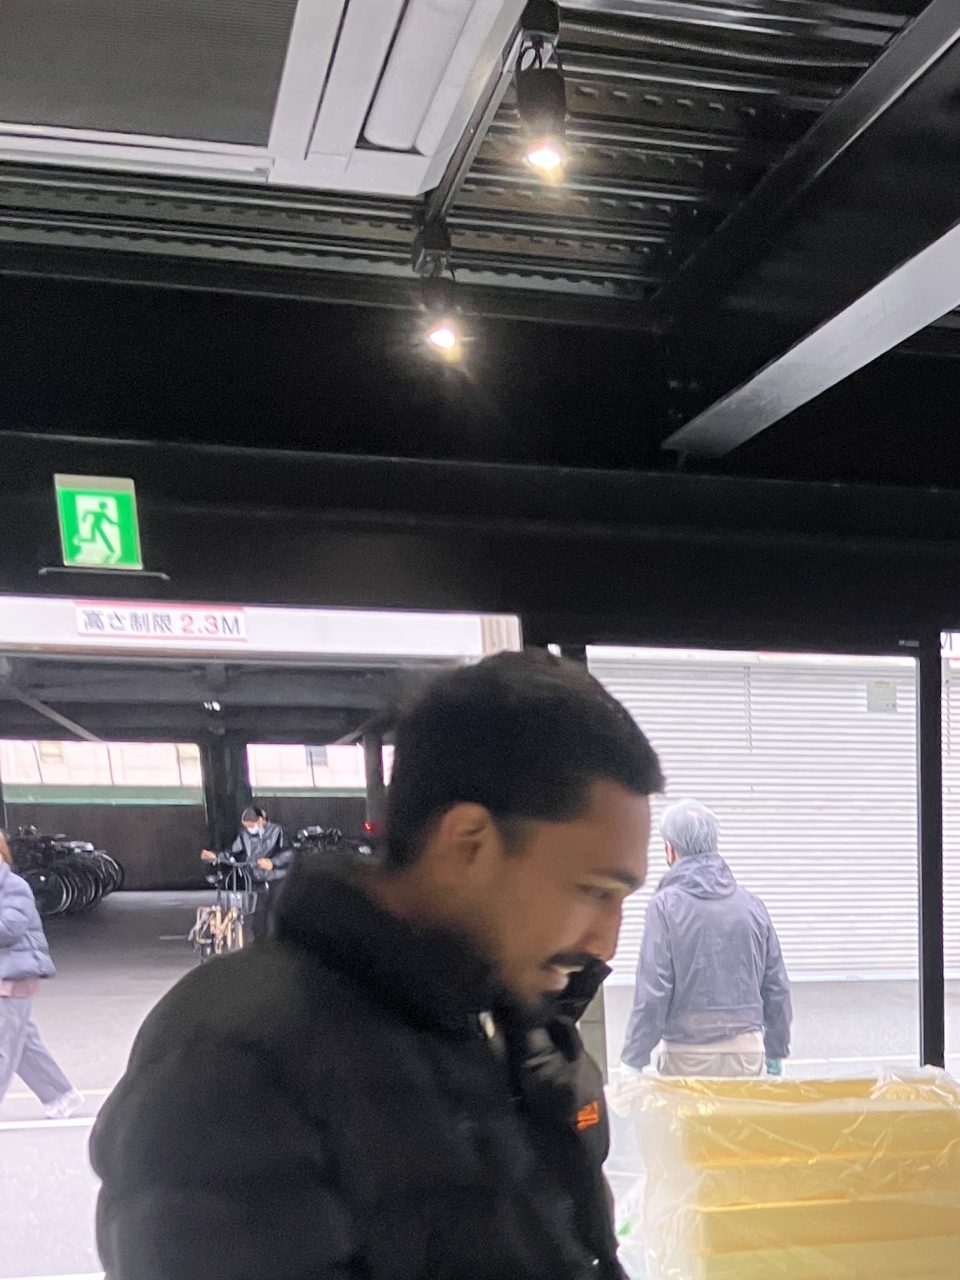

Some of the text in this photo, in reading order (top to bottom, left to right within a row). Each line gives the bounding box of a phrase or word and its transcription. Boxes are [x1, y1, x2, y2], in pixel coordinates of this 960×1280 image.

[83, 610, 240, 635] 高さ制限 2.3M
